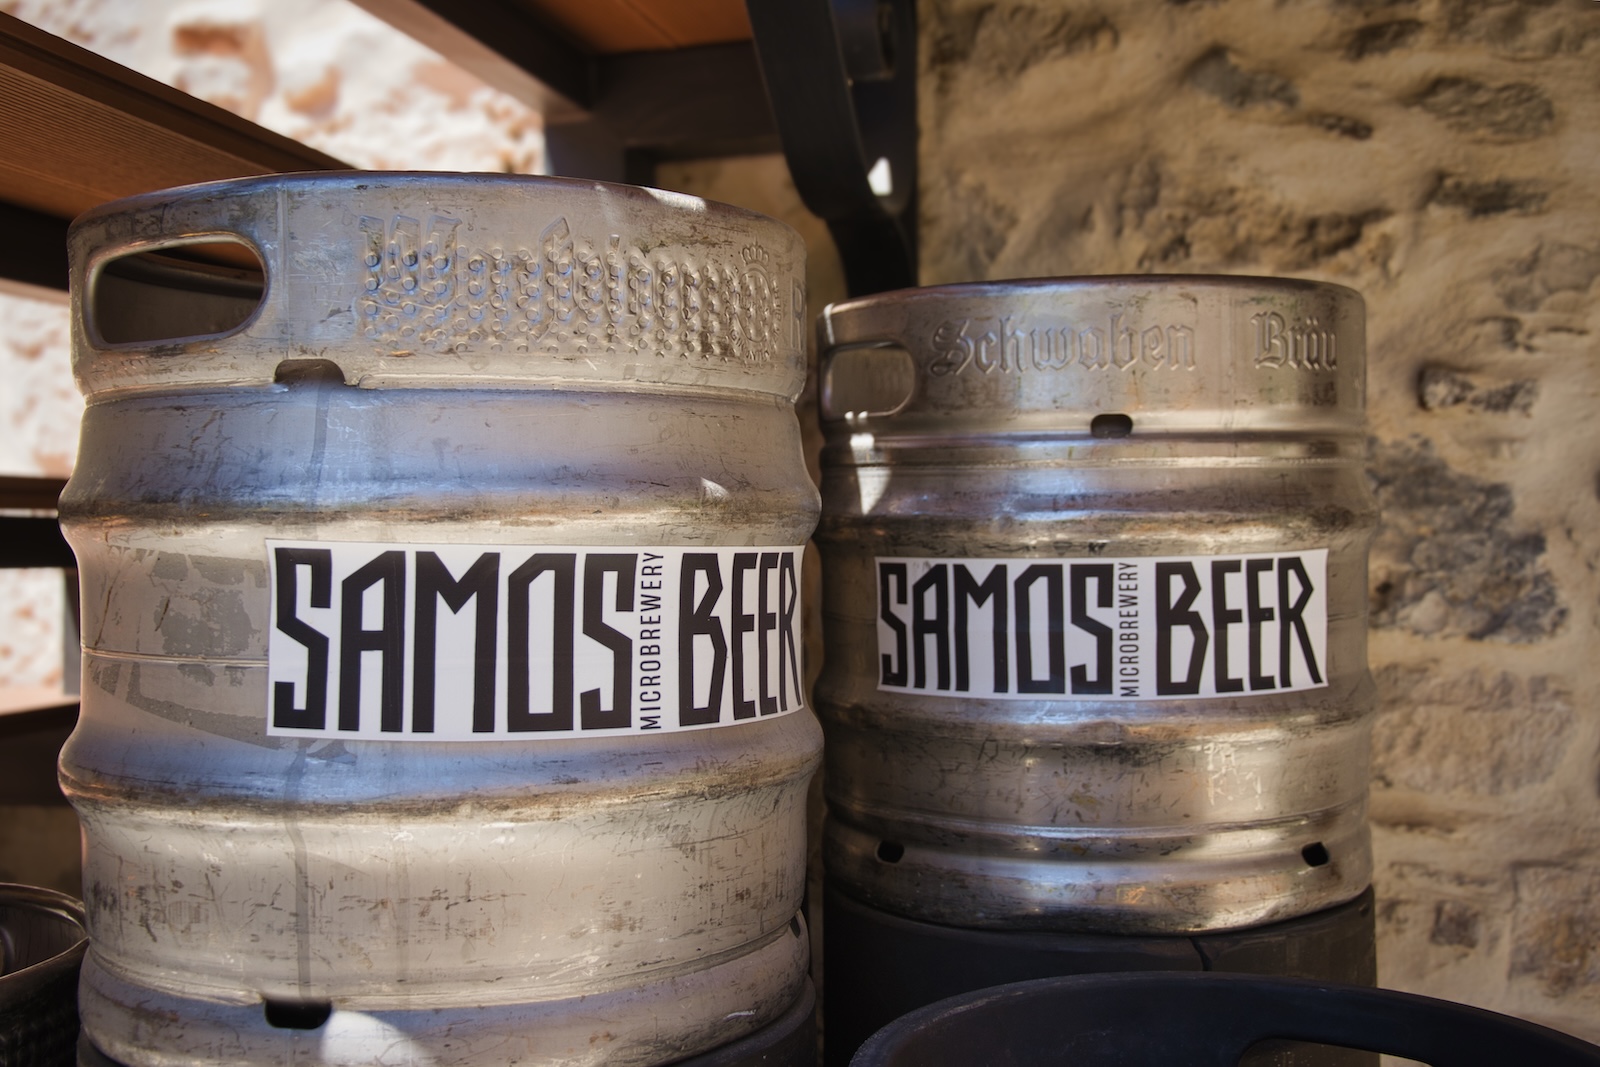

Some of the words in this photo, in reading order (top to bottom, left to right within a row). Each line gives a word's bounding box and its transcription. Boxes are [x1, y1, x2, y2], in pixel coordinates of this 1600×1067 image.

[928, 312, 1196, 376] Schwaben
[1250, 311, 1338, 371] Bräu
[273, 547, 638, 733] SAMOS
[678, 552, 804, 727] BEER
[640, 552, 665, 730] MICROBREWERY
[879, 562, 1114, 695] SAMOS
[1155, 556, 1324, 696] BEER
[1119, 562, 1140, 697] MICROBREWERY
